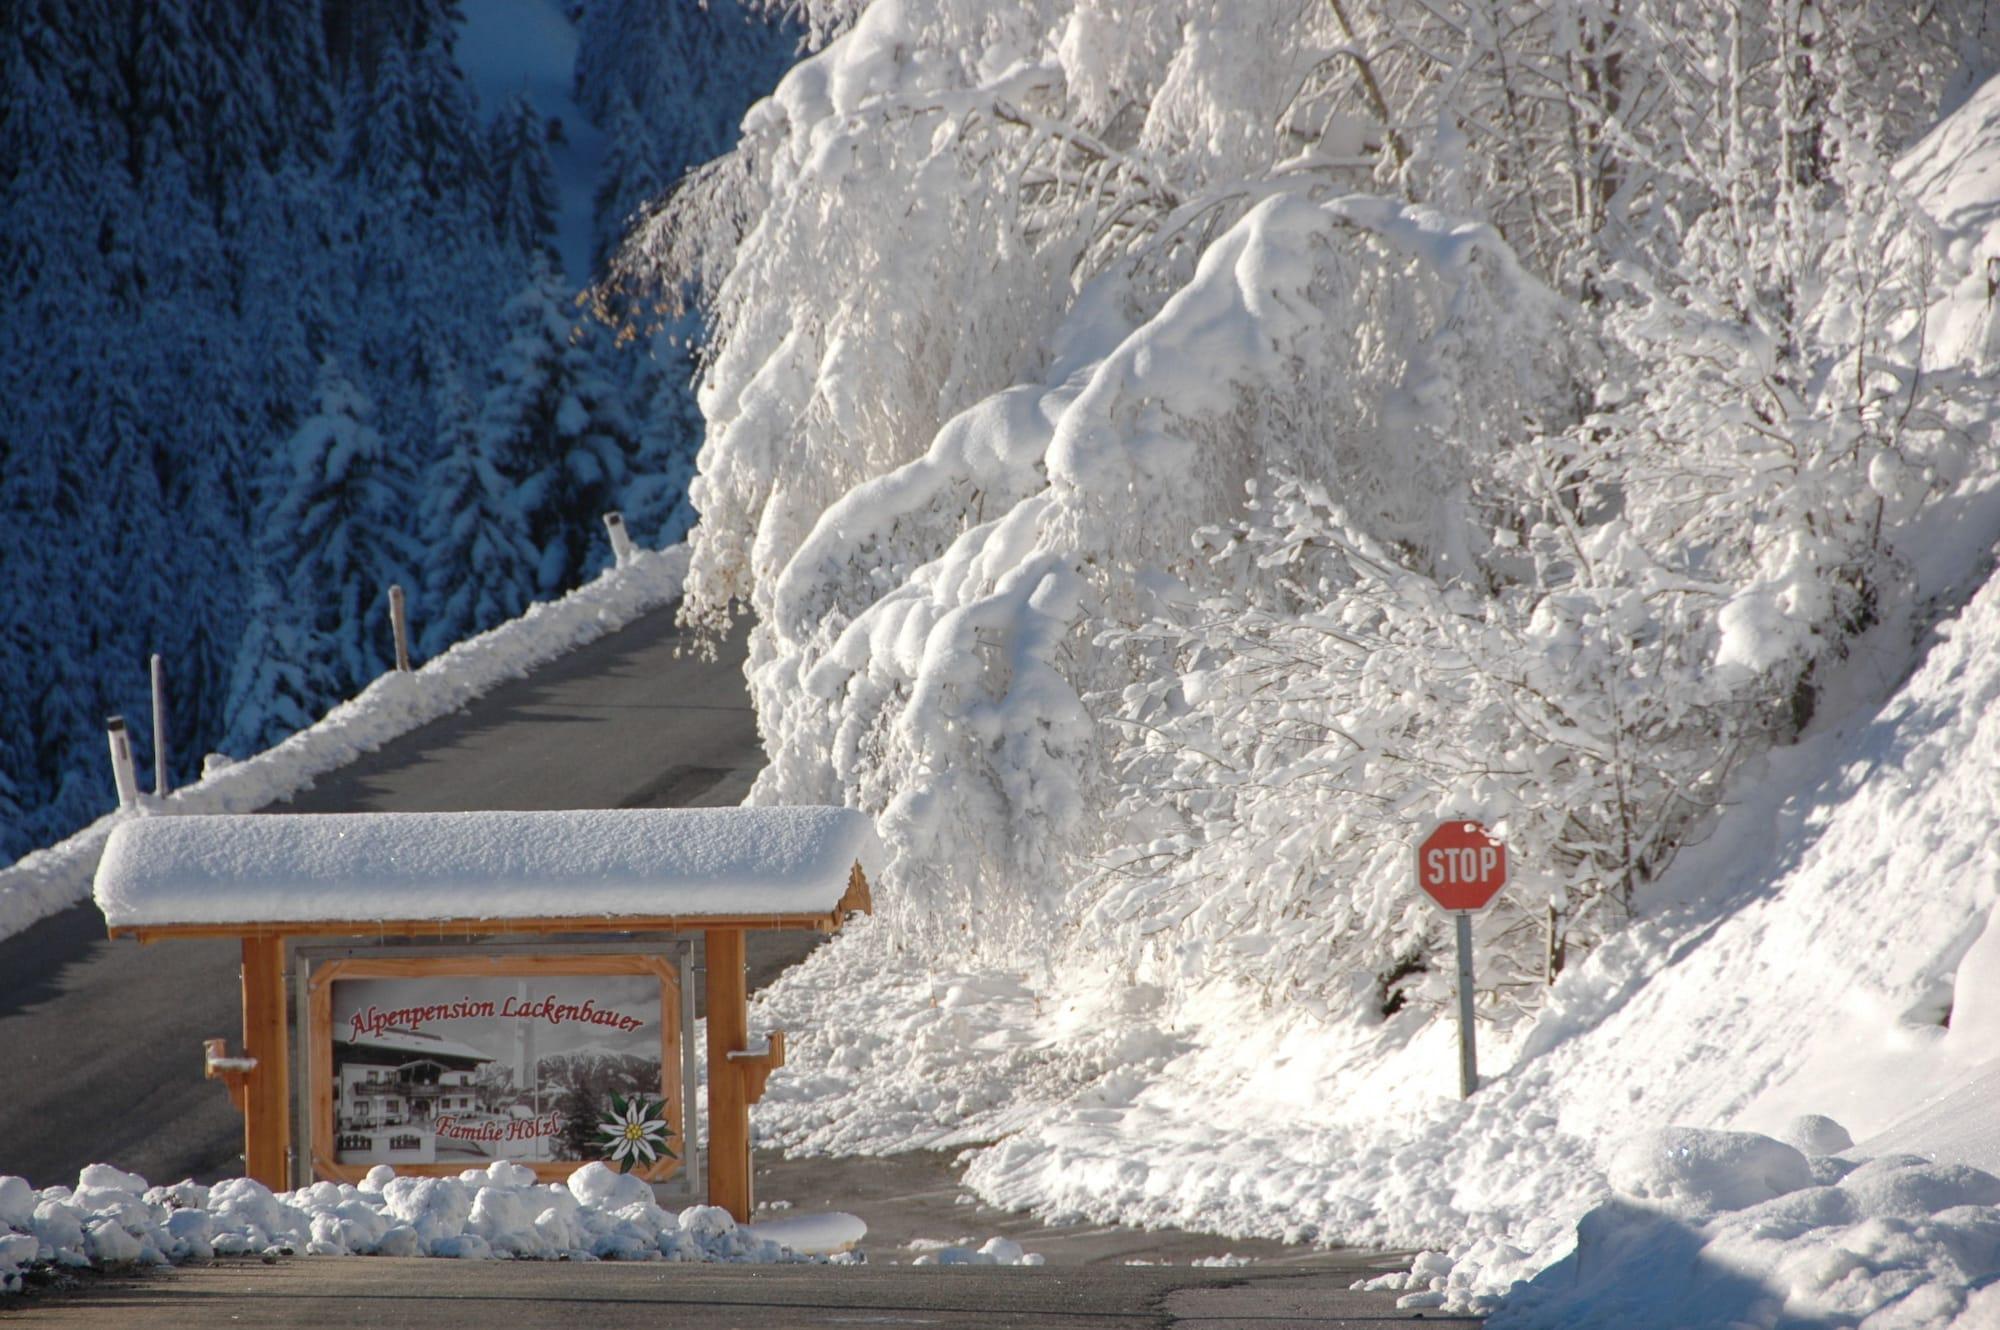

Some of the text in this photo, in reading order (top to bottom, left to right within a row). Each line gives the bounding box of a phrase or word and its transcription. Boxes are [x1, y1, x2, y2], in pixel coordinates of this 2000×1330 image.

[1427, 846, 1497, 885] STOP
[349, 995, 644, 1043] Alpenpension Lackenbauer
[435, 1111, 561, 1142] Familie Hölzl
